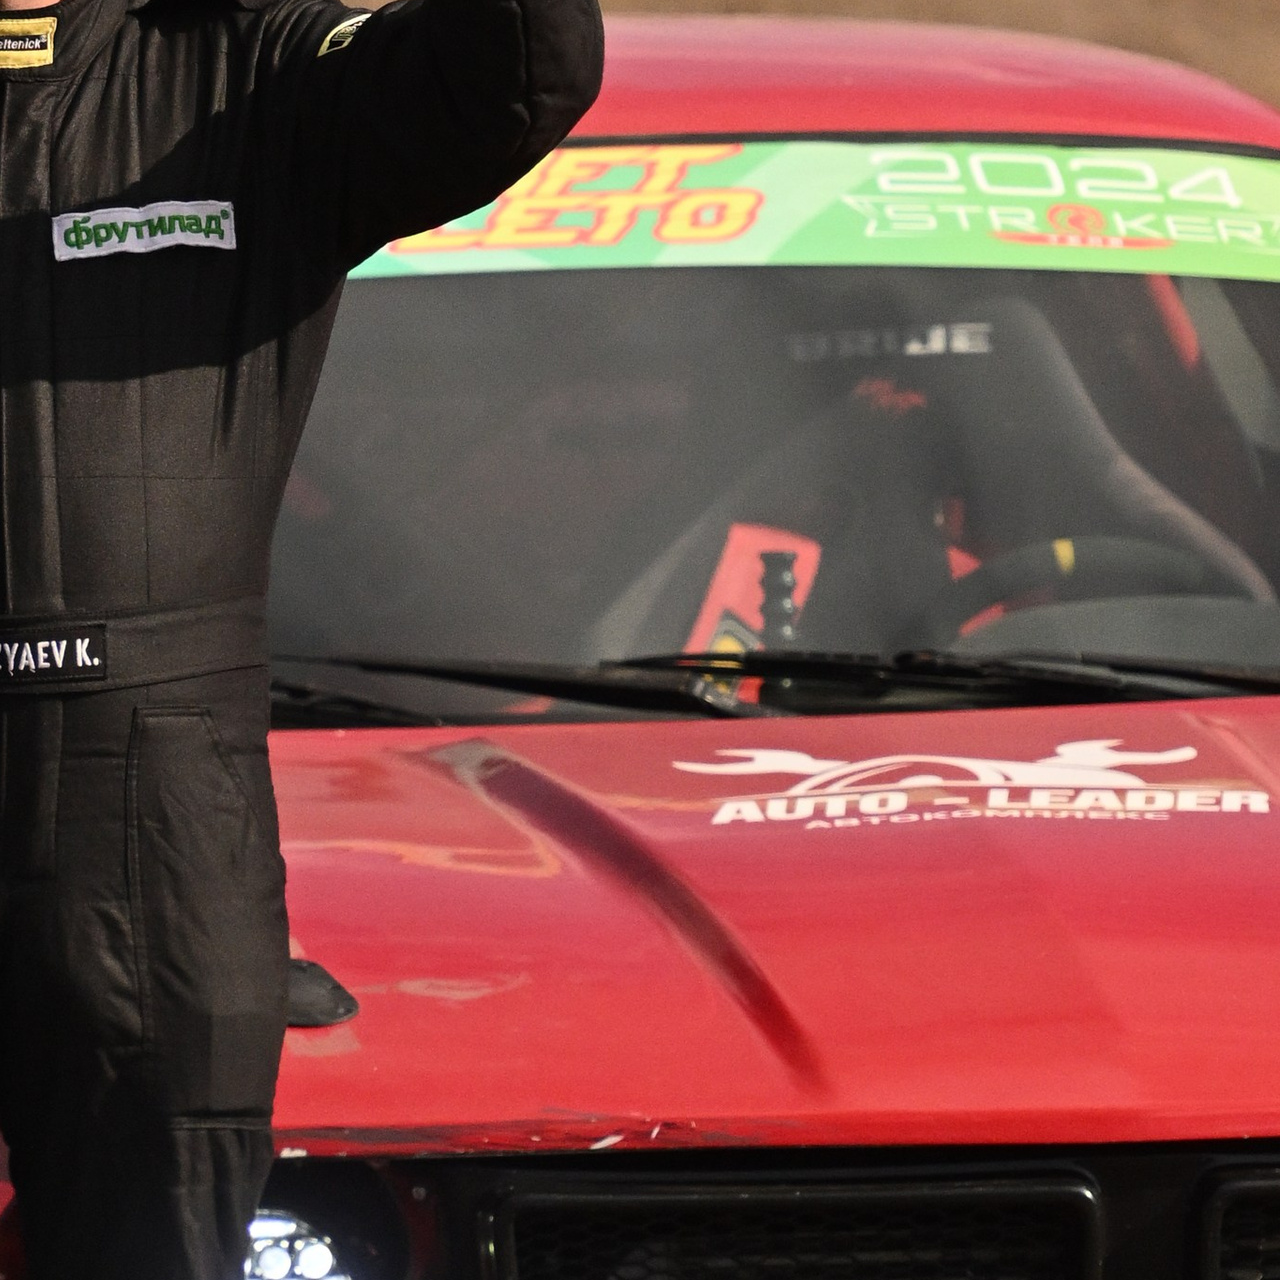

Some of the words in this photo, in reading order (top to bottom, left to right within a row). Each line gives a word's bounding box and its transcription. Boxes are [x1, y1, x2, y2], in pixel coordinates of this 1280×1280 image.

[870, 150, 1242, 208] 2024
[75, 637, 102, 668] K.
[987, 788, 1270, 814] LEADER
